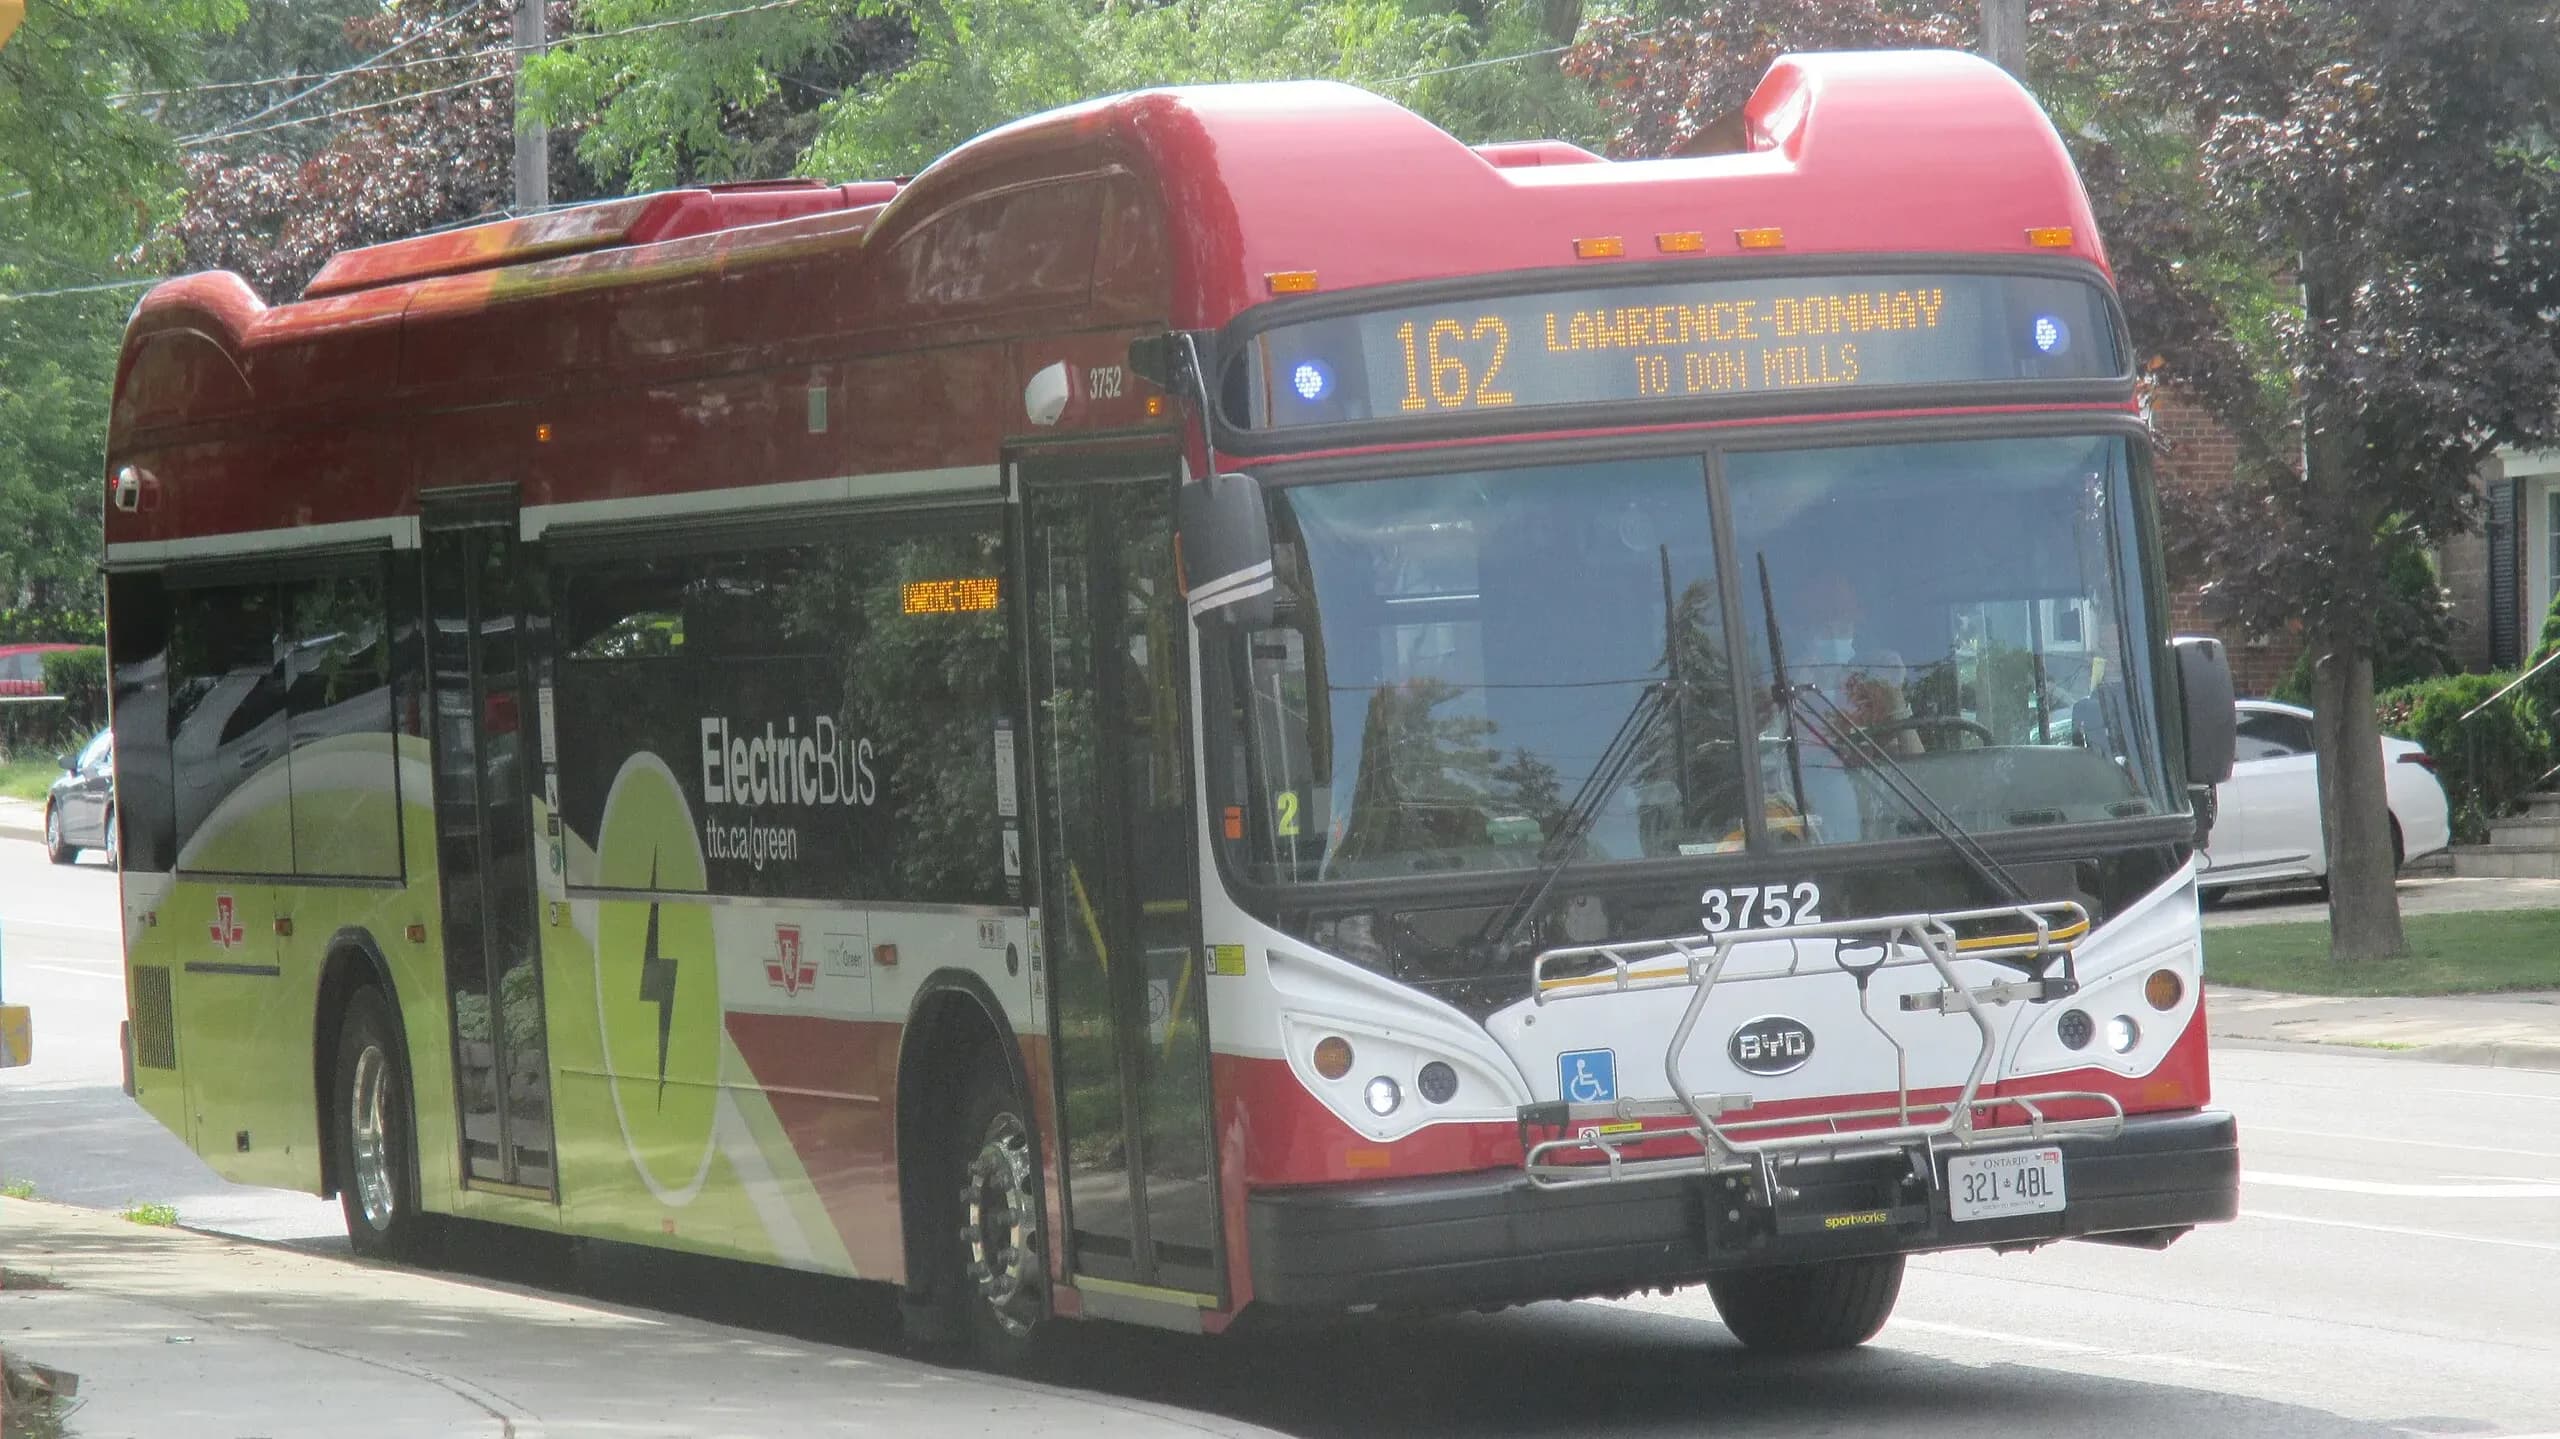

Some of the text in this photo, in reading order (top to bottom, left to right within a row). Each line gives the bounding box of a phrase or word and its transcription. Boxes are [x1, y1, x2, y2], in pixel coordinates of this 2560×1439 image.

[1546, 288, 1943, 352] LAWRENCE-DONWAY
[1090, 366, 1122, 399] 3752
[1397, 313, 1514, 411] 162
[1635, 342, 1861, 395] TO DON MILLS
[701, 715, 876, 807] ElectricBus
[1277, 791, 1300, 837] 2
[706, 815, 798, 871] ttc.ca/green
[1701, 881, 1822, 932] 3752
[1739, 1031, 1807, 1060] BYD
[1962, 1167, 2054, 1203] 321 4BL
[1983, 1155, 2028, 1170] ONTARIO
[1824, 1211, 1887, 1229] sportworks
